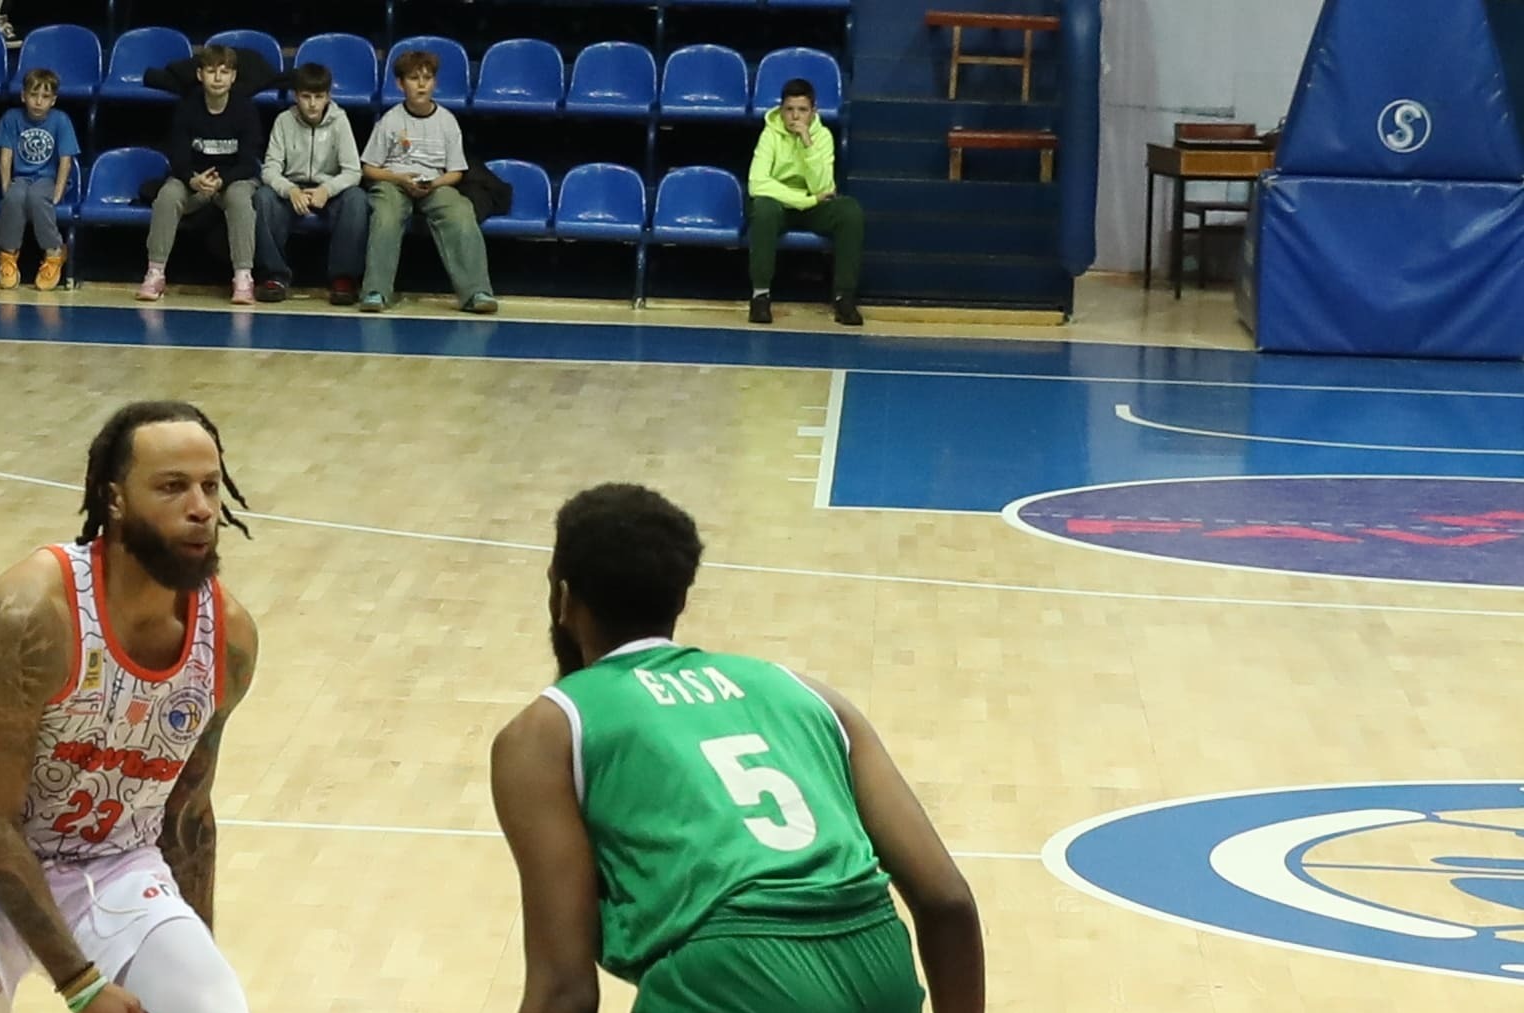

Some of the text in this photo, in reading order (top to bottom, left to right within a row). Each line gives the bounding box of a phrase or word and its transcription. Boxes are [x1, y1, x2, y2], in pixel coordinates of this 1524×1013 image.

[634, 667, 745, 705] EISA
[52, 789, 124, 844] 23
[699, 733, 817, 851] 5
